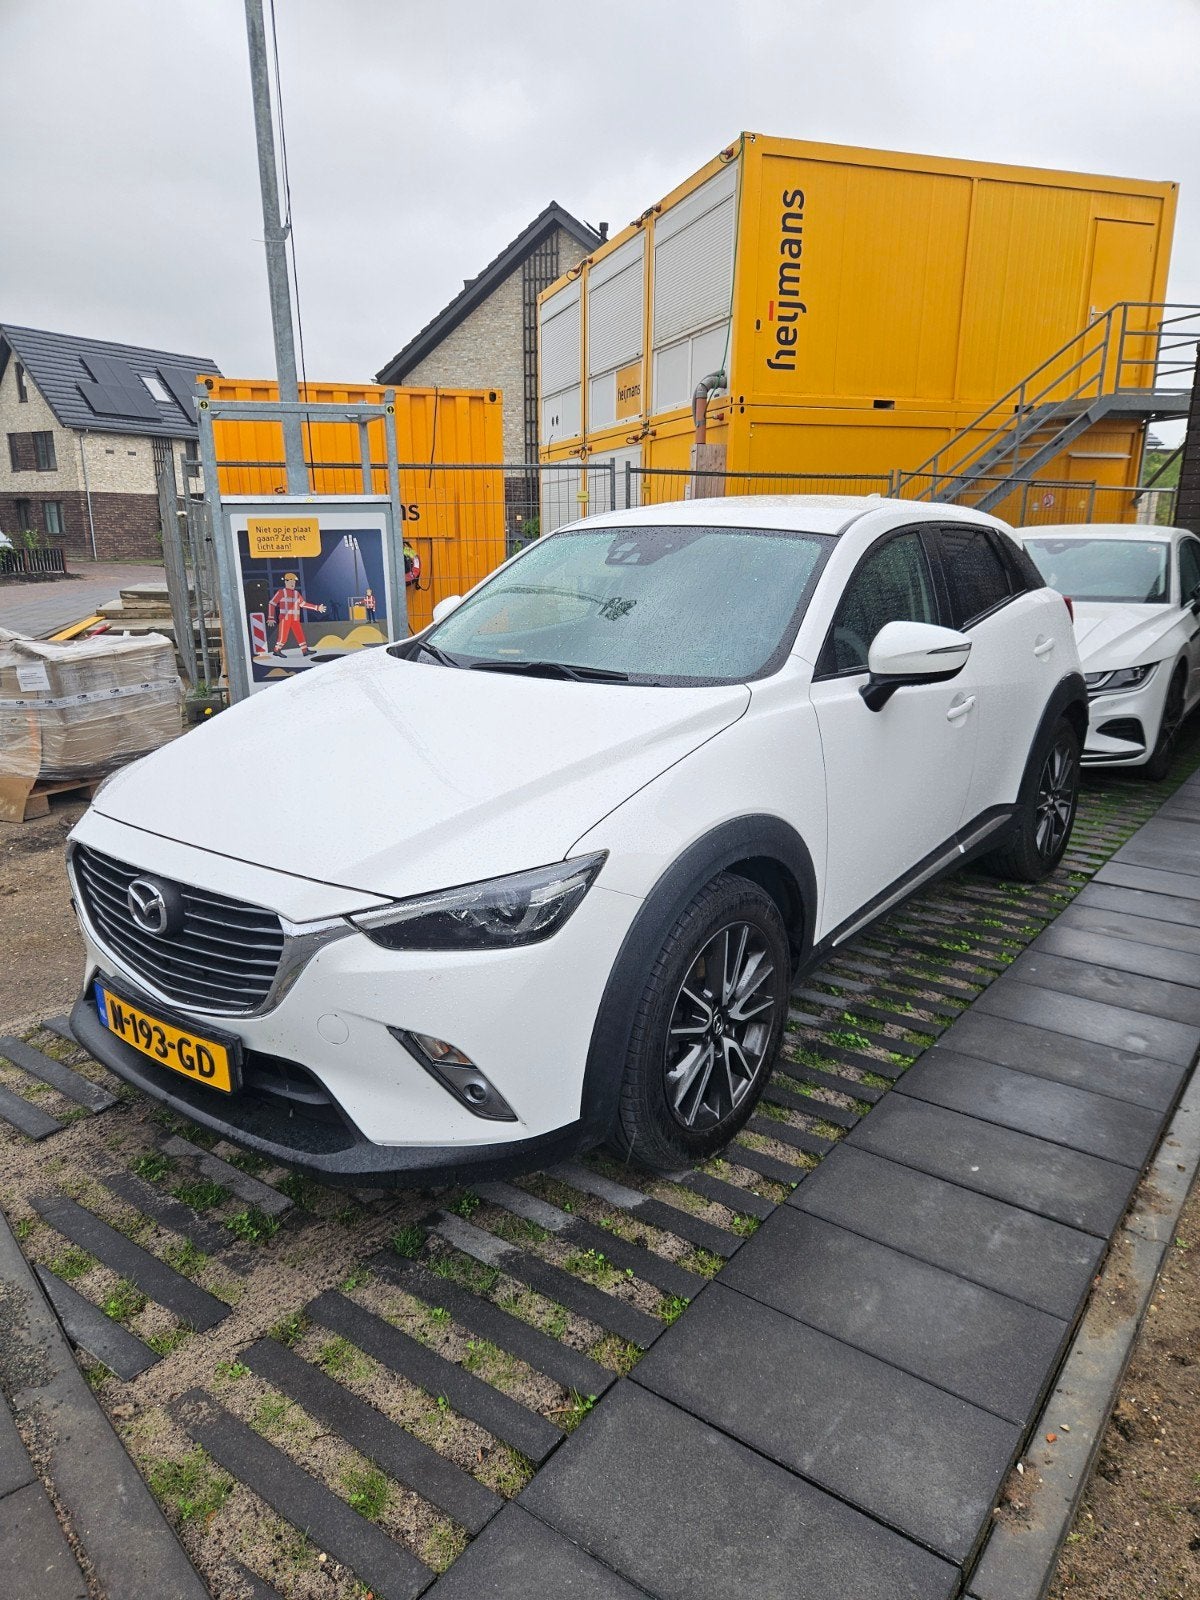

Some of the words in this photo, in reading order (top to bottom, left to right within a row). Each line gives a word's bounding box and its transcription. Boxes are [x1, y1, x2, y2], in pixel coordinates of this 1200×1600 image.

[767, 189, 807, 370] heijmans
[617, 384, 641, 403] heijmans
[256, 534, 279, 543] gaan?
[284, 526, 291, 535] je
[293, 526, 311, 535] plaat
[110, 1000, 215, 1078] N-193-GD
